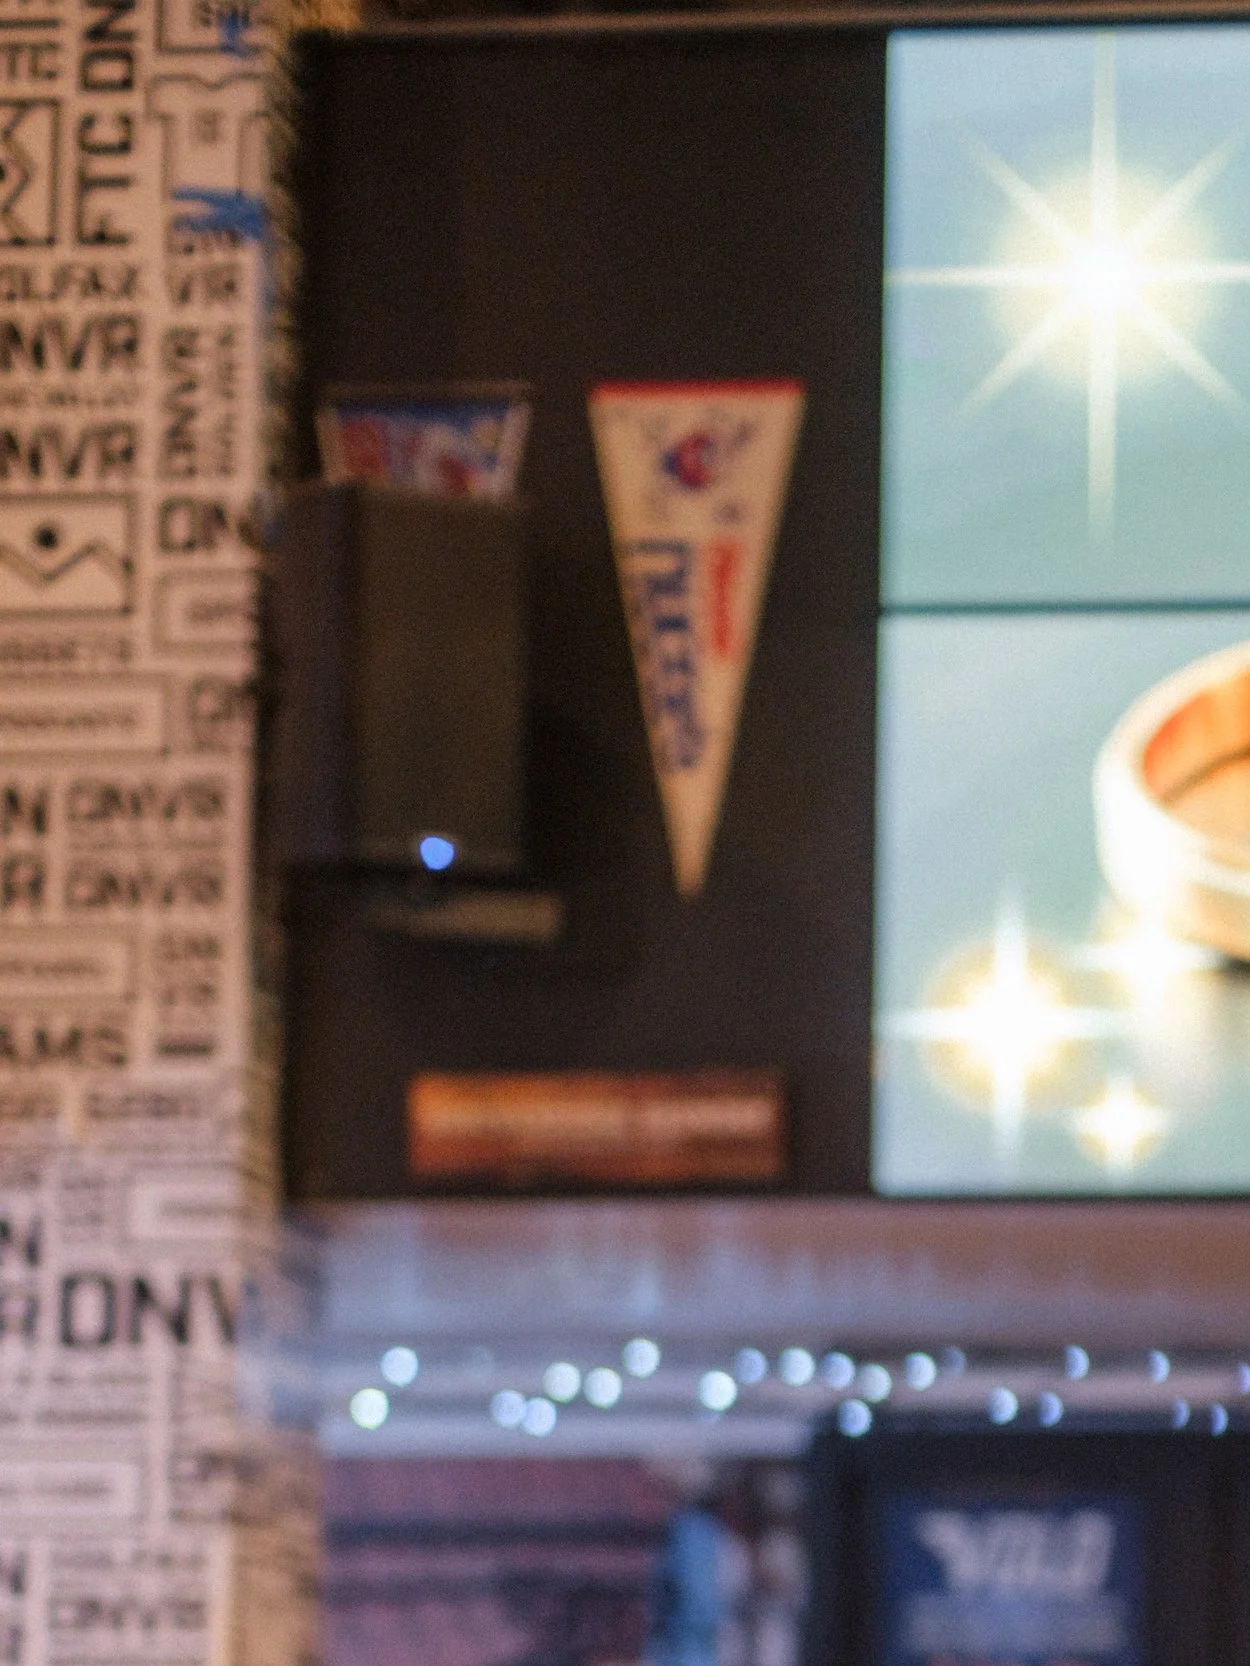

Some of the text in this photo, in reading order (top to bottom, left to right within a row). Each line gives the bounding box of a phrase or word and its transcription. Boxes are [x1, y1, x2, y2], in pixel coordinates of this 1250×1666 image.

[76, 110, 135, 248] FTC
[0, 313, 140, 374] NVR
[0, 420, 140, 481] NVR
